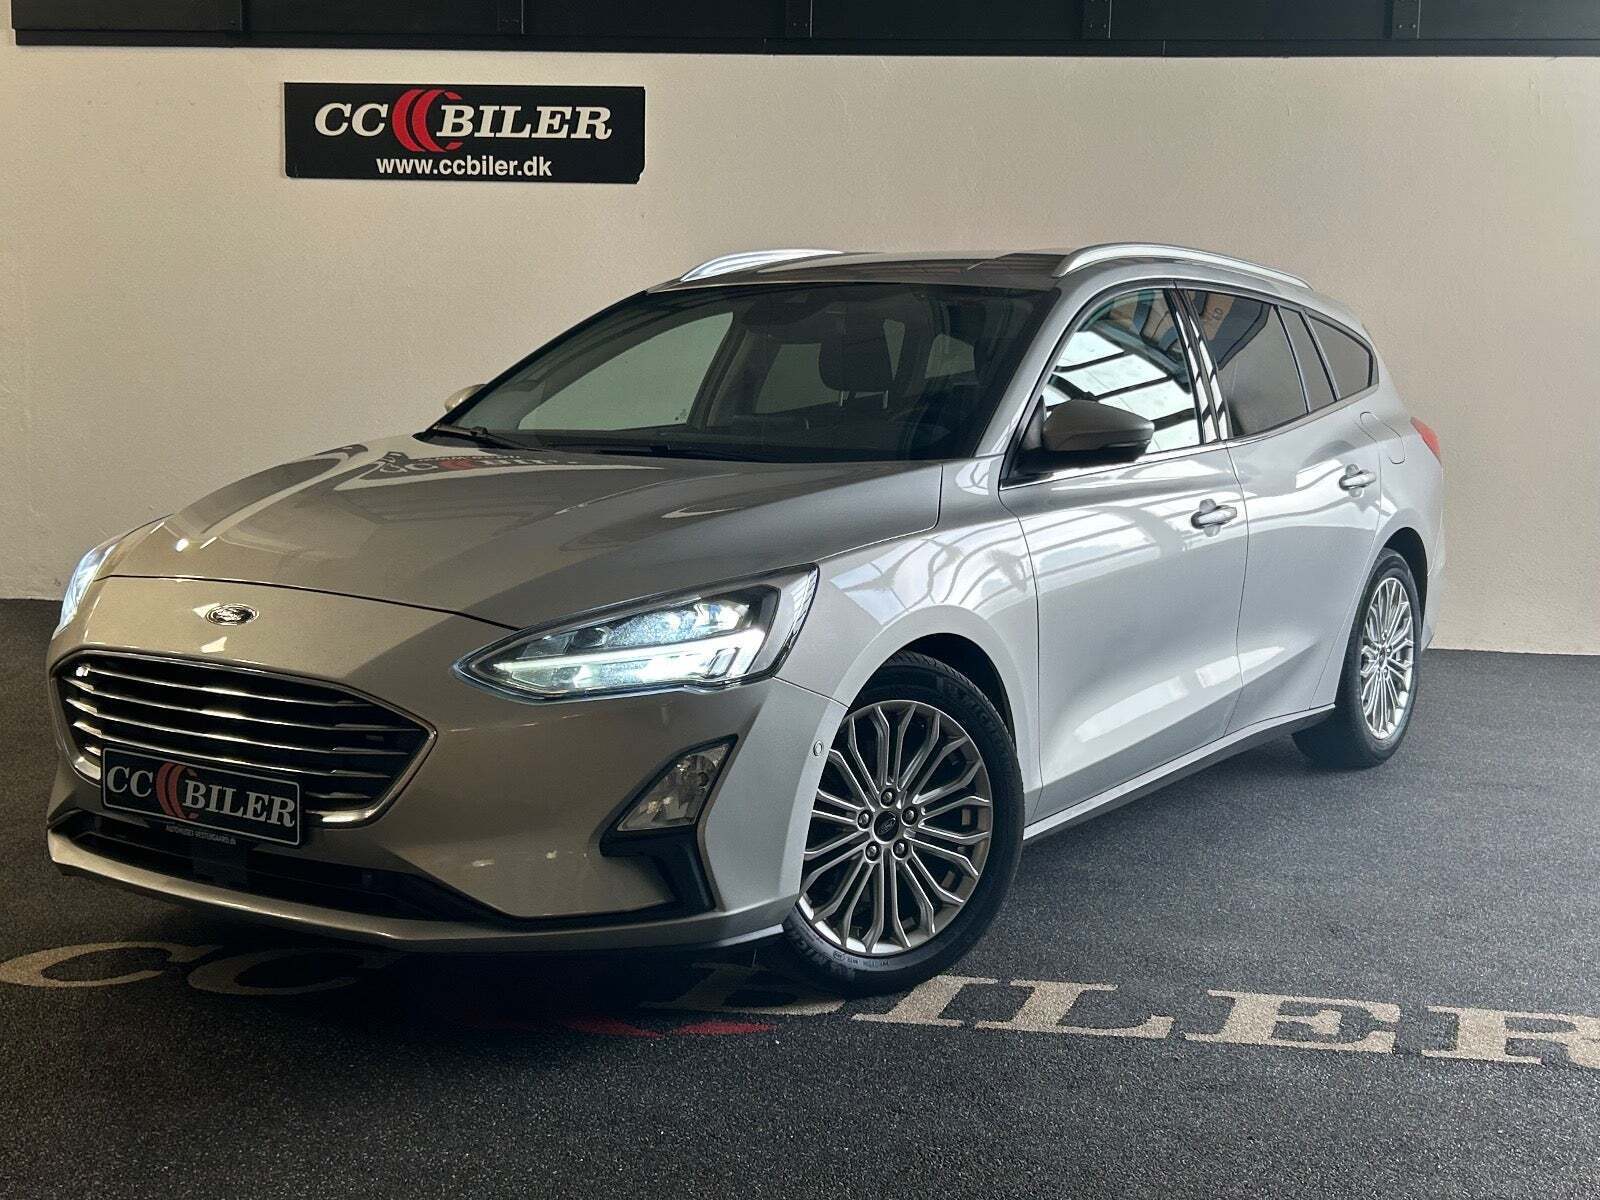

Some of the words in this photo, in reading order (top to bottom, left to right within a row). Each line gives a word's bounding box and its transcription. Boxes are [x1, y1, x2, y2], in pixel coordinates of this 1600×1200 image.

[314, 102, 389, 137] CC
[436, 104, 613, 140] BILER
[376, 155, 553, 177] www.ccbiler.dk
[106, 765, 154, 798] CC
[182, 779, 296, 828] BILER
